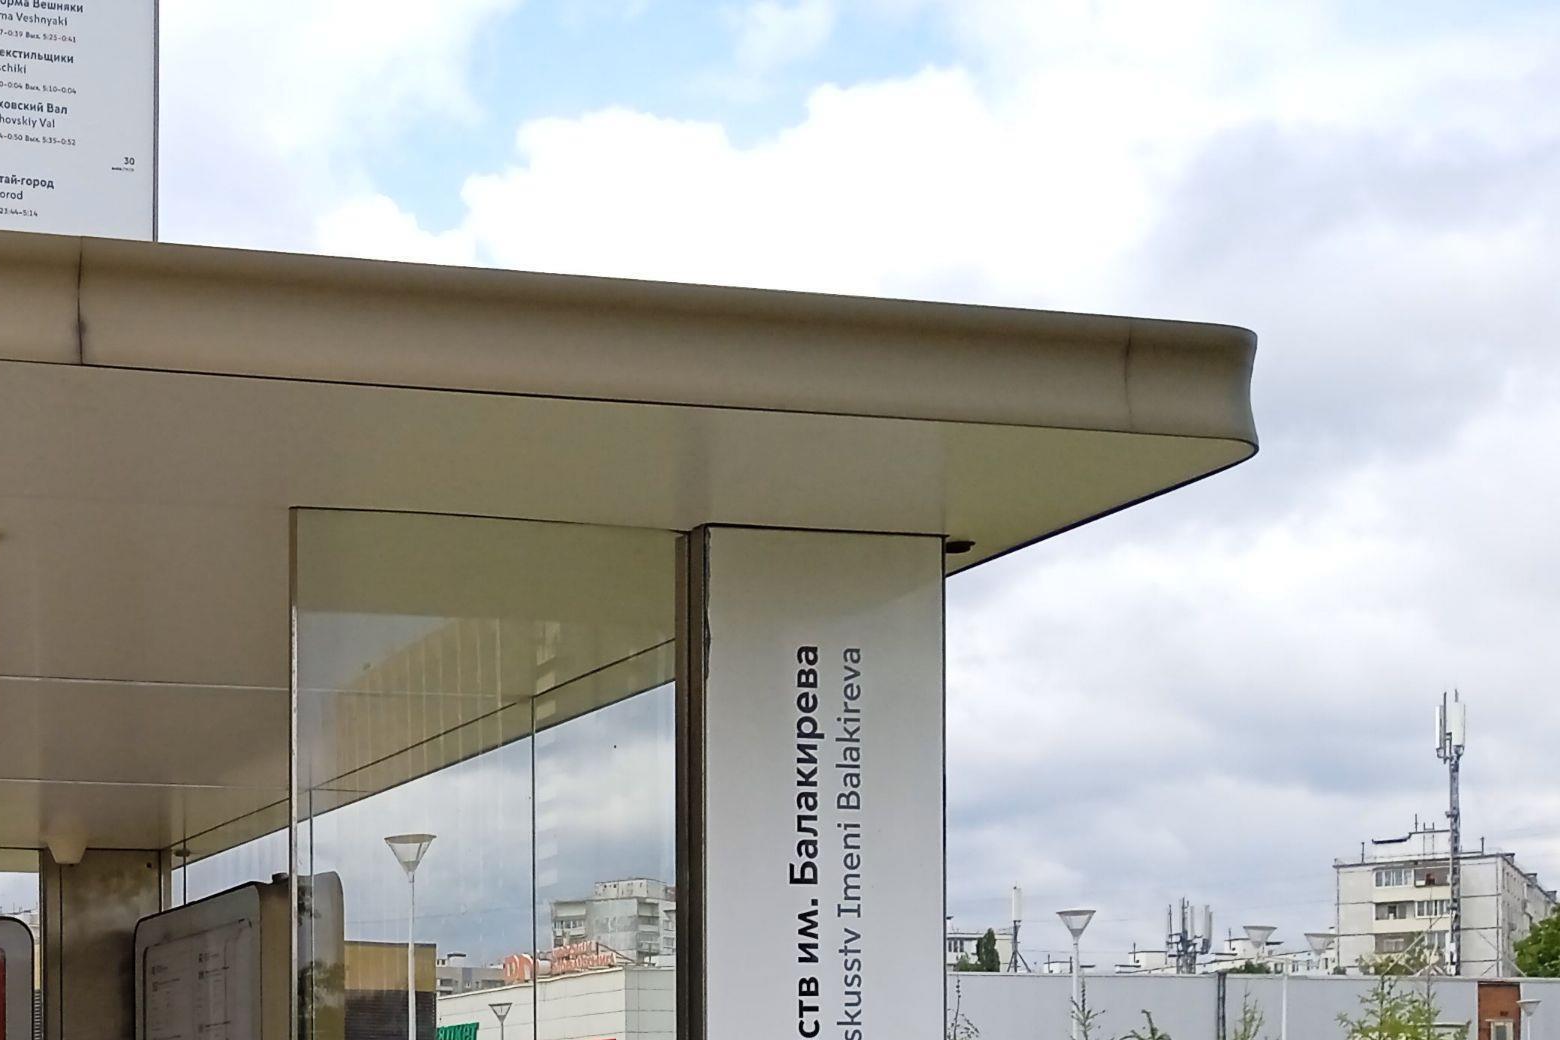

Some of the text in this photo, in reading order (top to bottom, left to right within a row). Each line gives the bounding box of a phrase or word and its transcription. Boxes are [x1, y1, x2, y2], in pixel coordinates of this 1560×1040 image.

[33, 0, 83, 12] Вешняки
[16, 12, 68, 26] Veshnyaki
[47, 103, 68, 114] Вал
[39, 118, 55, 128] Val
[123, 157, 135, 165] 30
[835, 647, 861, 810] Balakireva
[789, 645, 825, 885] Балакирева
[837, 822, 861, 918] Imeni
[798, 898, 819, 963] им.
